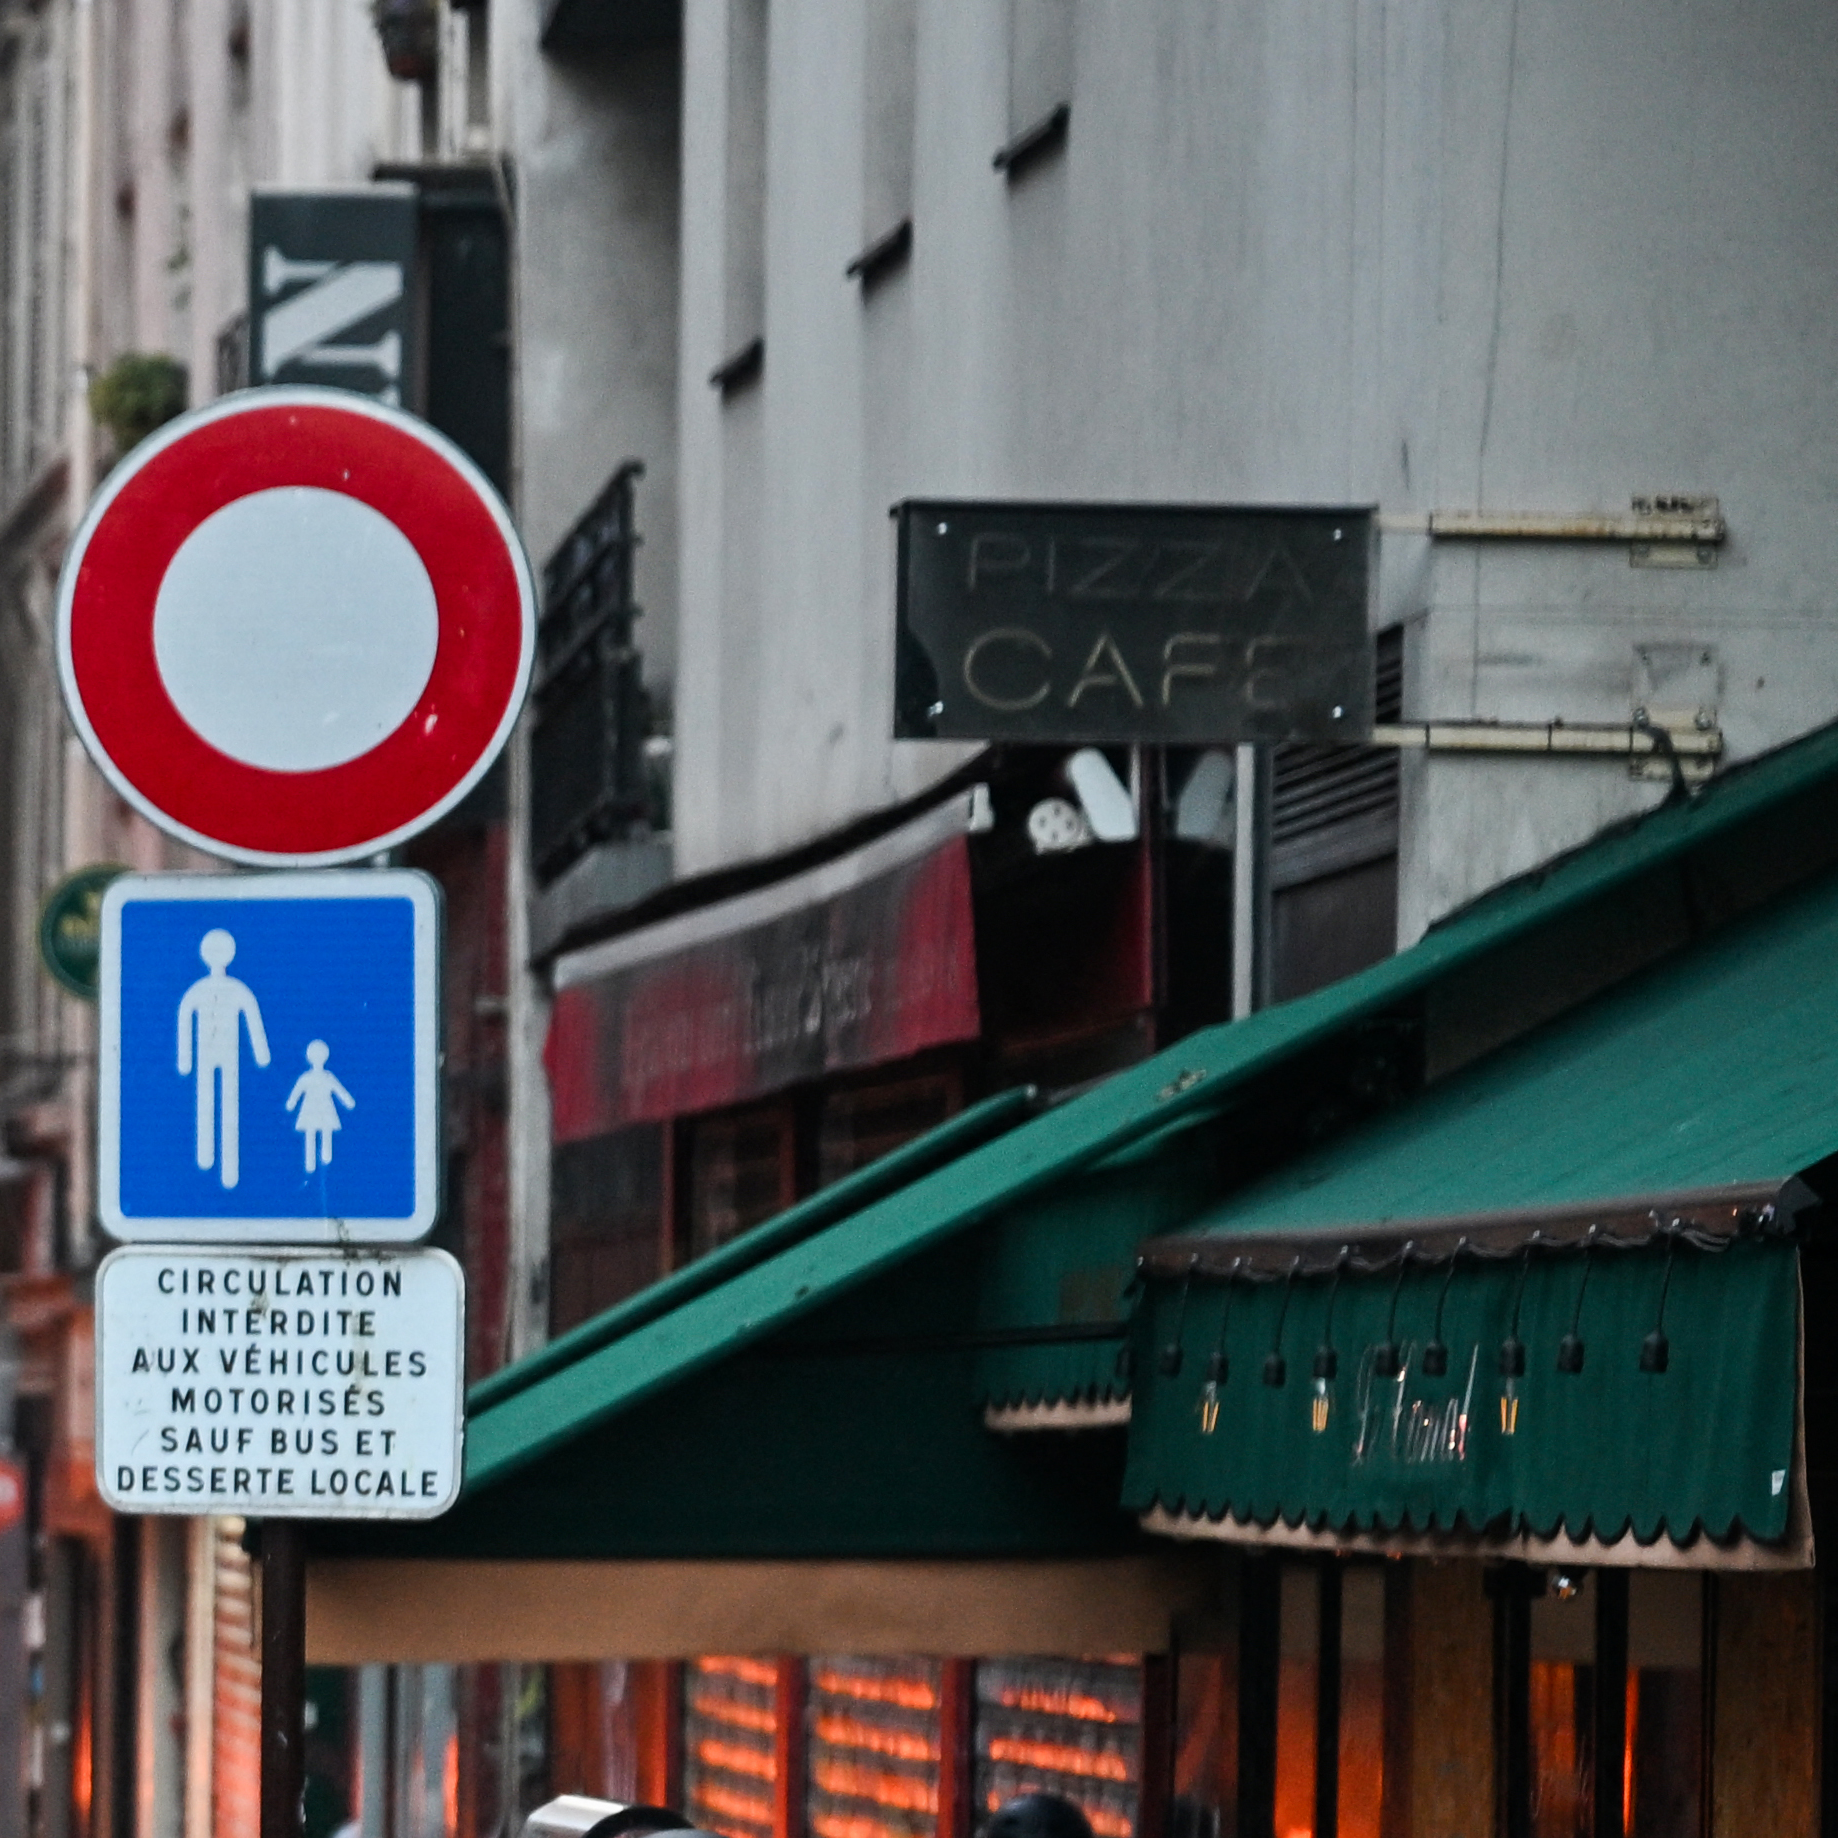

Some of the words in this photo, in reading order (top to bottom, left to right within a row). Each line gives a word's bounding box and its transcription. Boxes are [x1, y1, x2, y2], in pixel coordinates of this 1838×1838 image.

[967, 532, 1314, 601] PIZZA
[158, 1268, 402, 1297] CIRCULATION
[182, 1308, 375, 1337] INTERDITE
[132, 1347, 200, 1374] AUX
[220, 1343, 427, 1377] VÉHICULES
[171, 1384, 385, 1416] MOTORISÉS
[161, 1427, 253, 1454] SAUF
[271, 1428, 339, 1455] BUS
[357, 1430, 396, 1456] ET
[117, 1465, 294, 1495] DESSERTE
[311, 1469, 439, 1497] LOCALE
